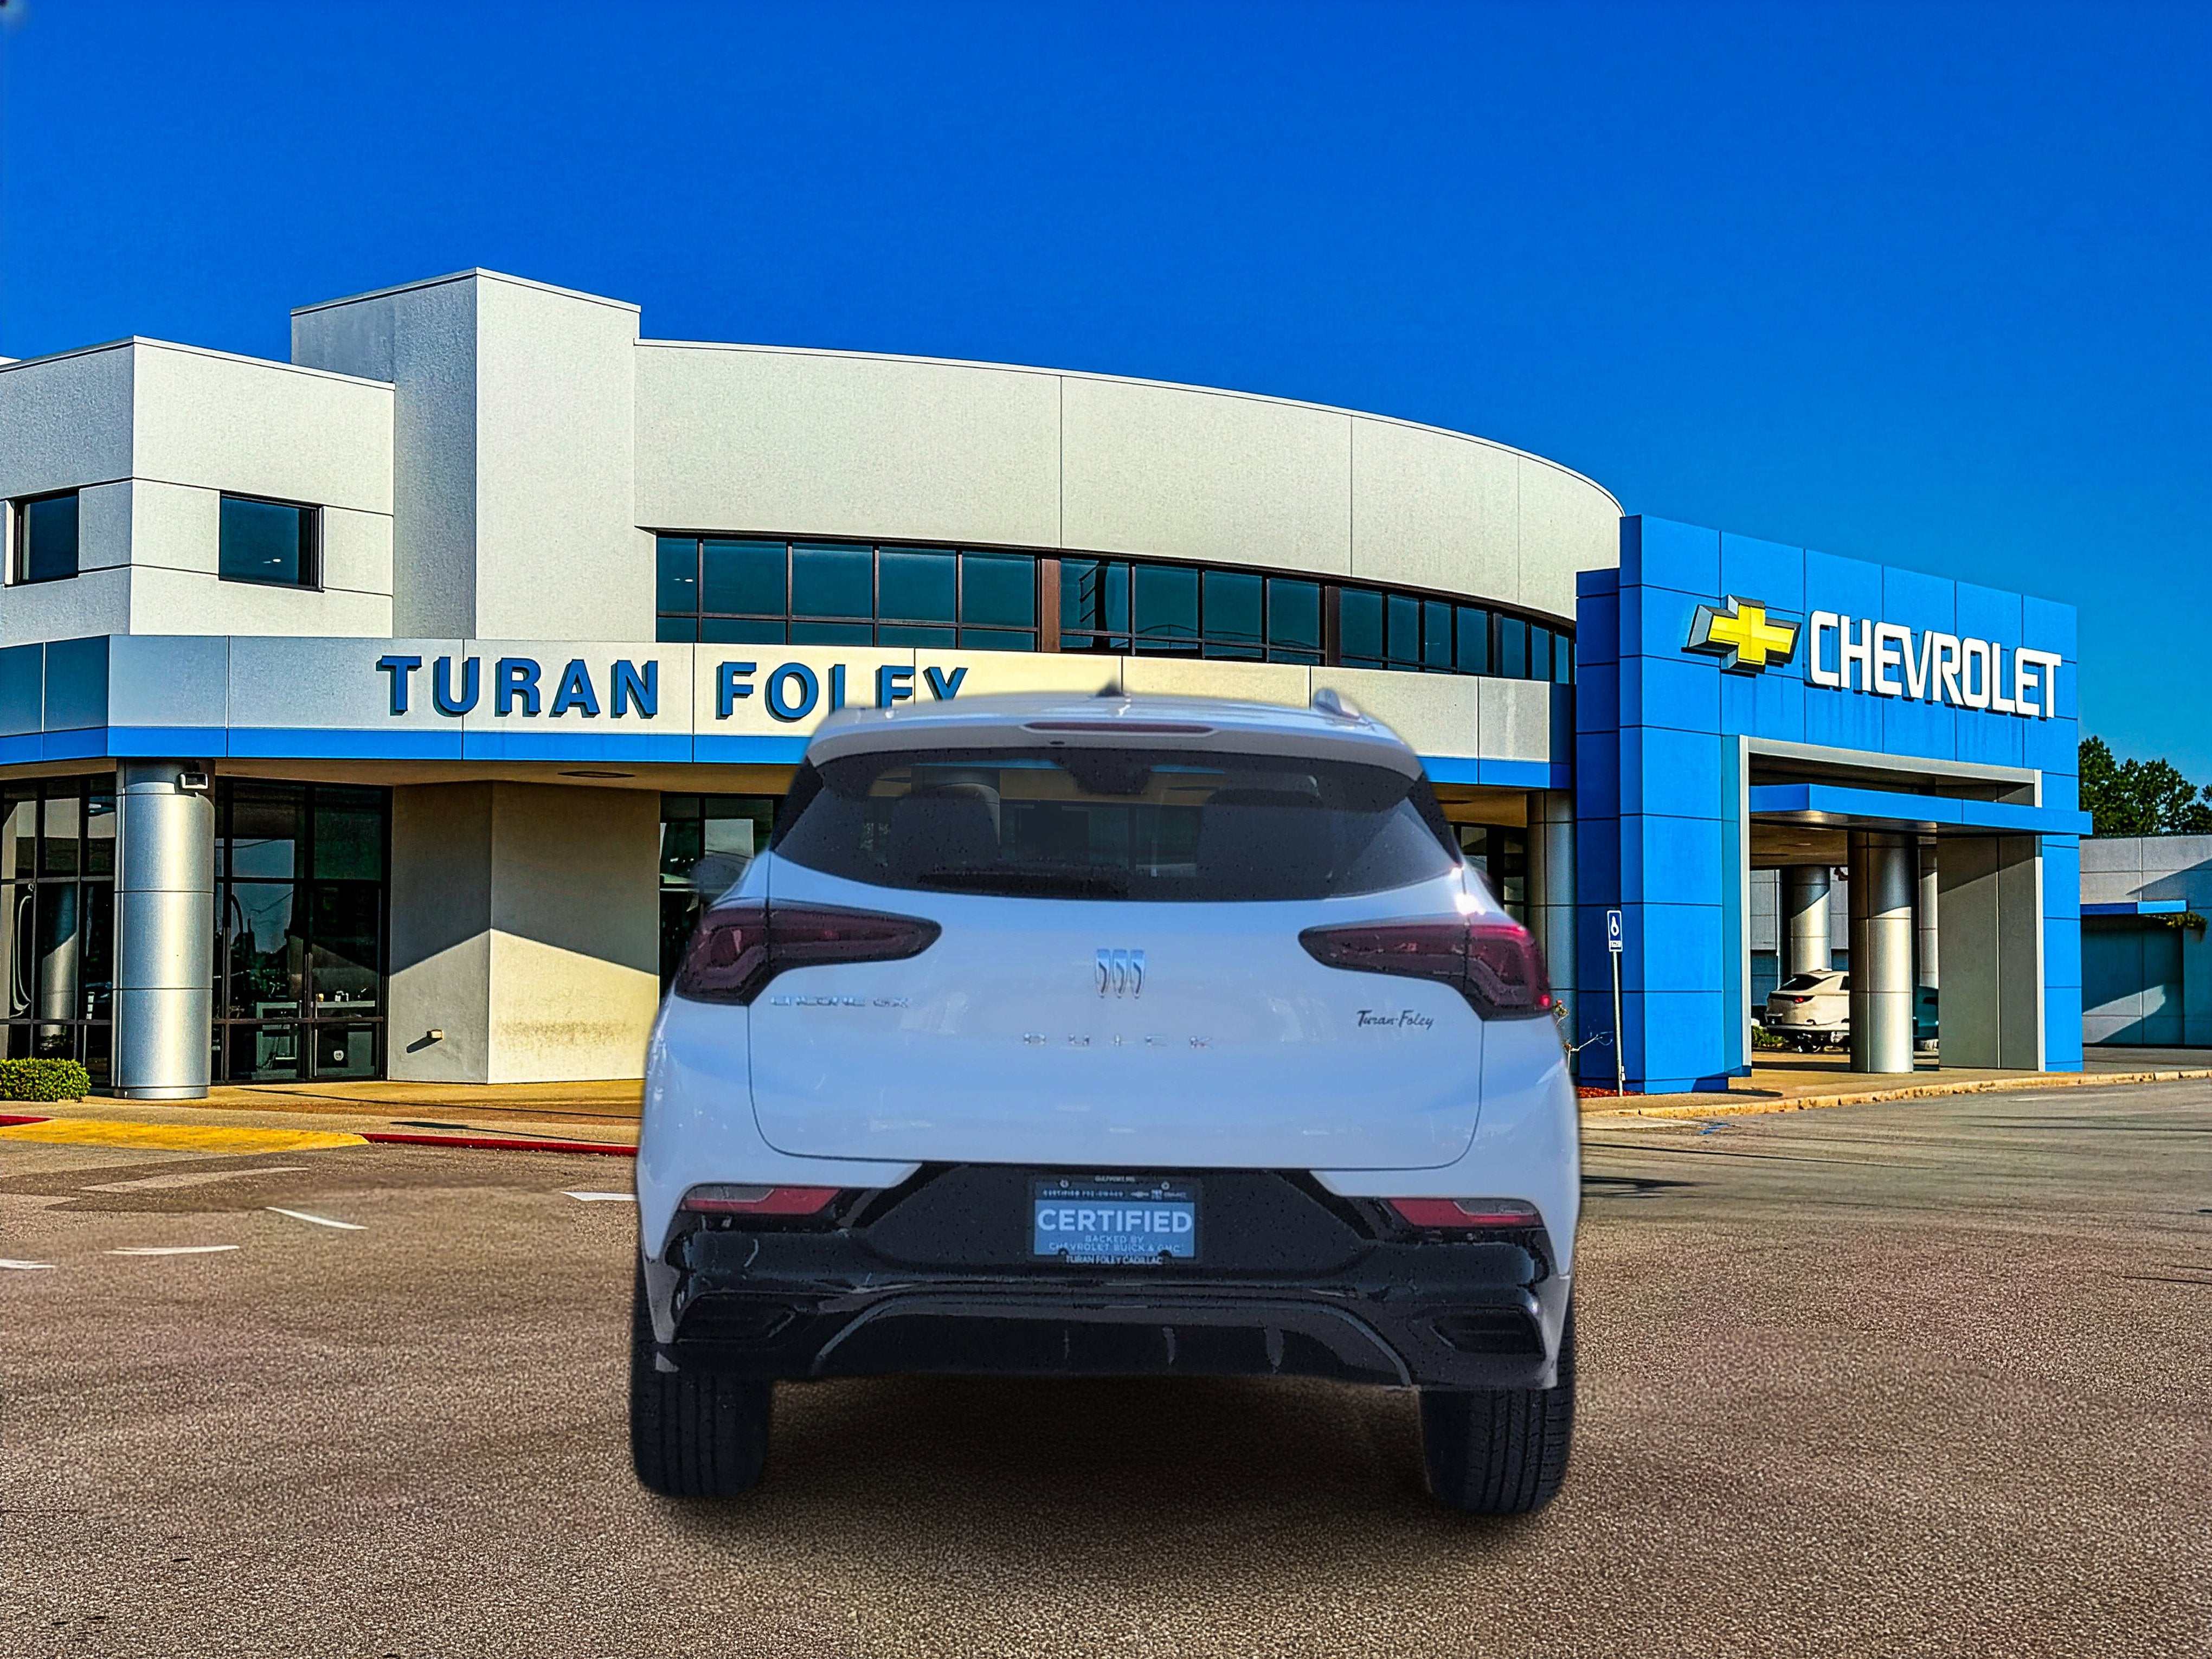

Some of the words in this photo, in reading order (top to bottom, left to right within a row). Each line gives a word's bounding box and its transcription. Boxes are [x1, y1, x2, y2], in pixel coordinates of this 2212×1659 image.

[1809, 610, 2062, 719] CHEVROLET
[376, 655, 659, 719] TURAN
[1357, 1009, 1397, 1027] Turan
[1398, 1009, 1435, 1031] Foley
[1037, 1208, 1193, 1233] CERTIFIED
[1049, 1242, 1110, 1252] CHEVROLET
[1113, 1243, 1145, 1252] BUICK
[1085, 1234, 1127, 1243] BACKED
[1130, 1235, 1144, 1244] BY
